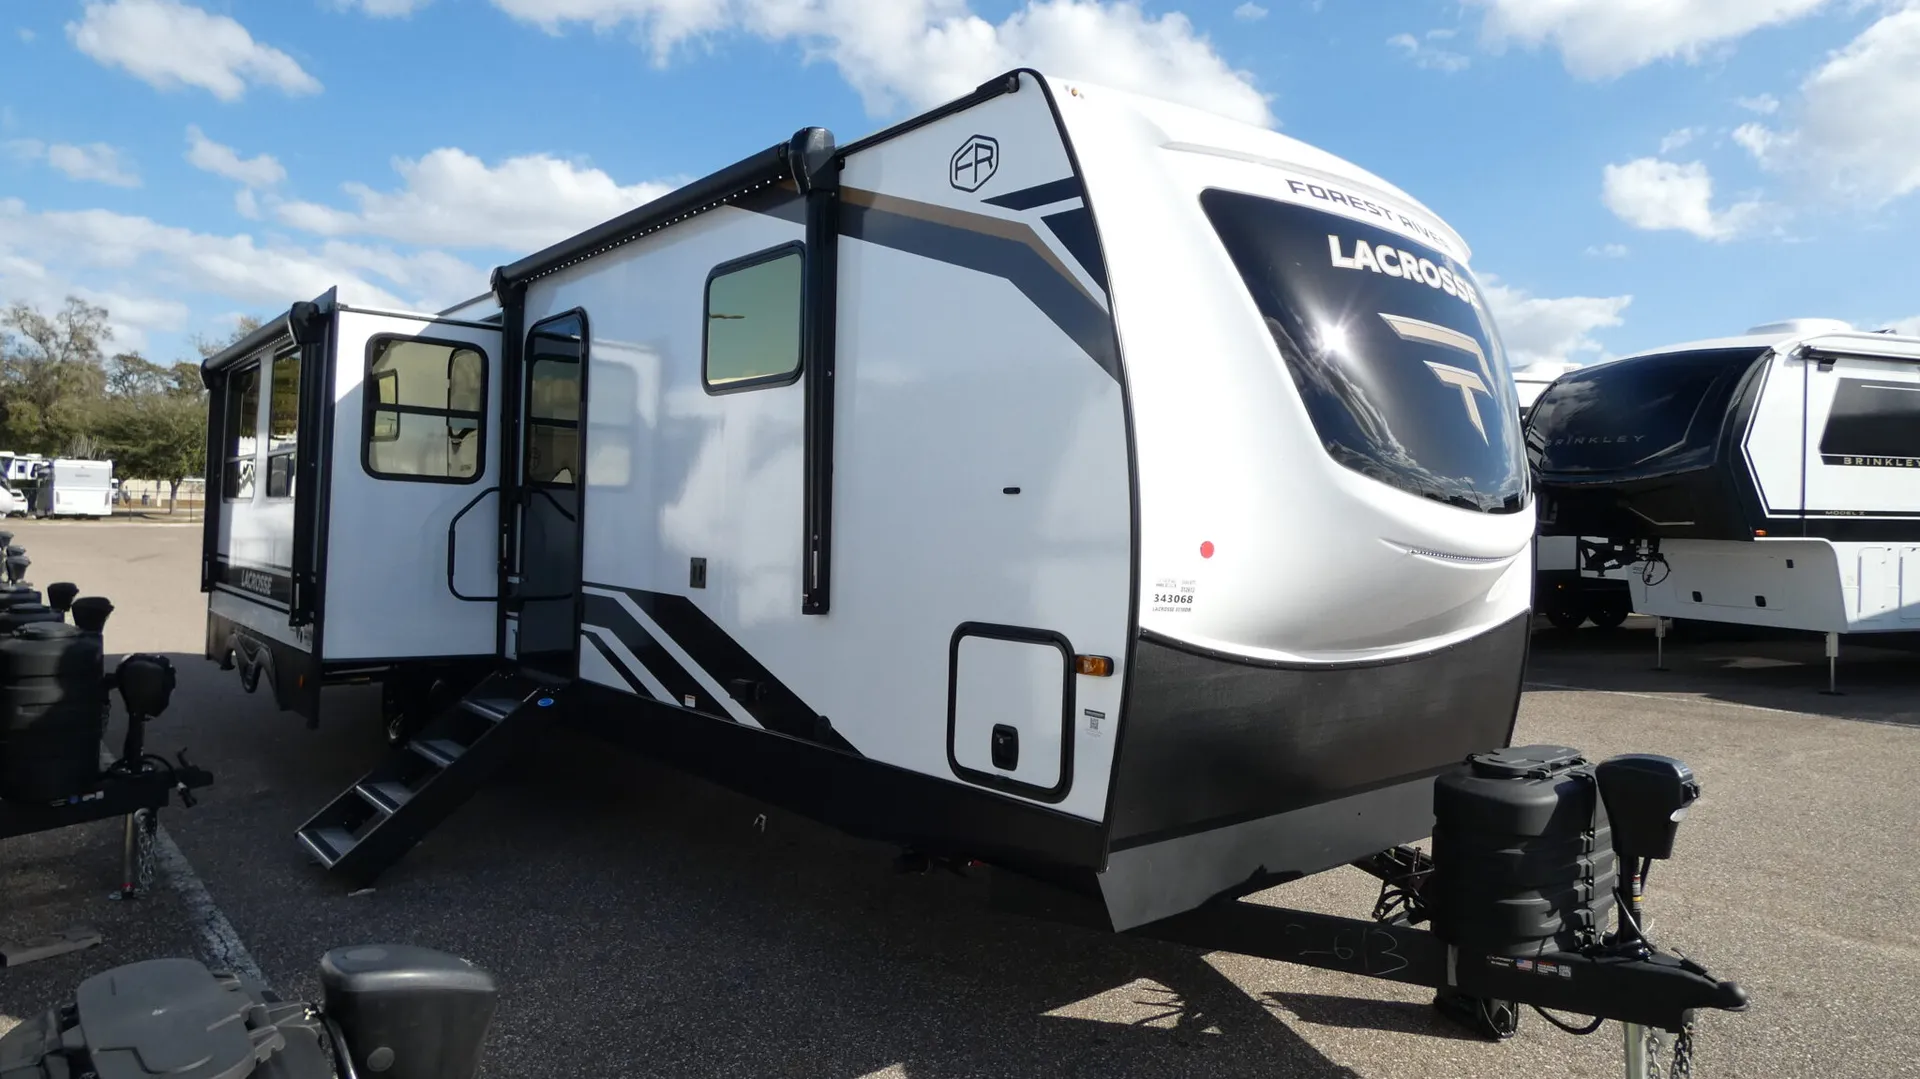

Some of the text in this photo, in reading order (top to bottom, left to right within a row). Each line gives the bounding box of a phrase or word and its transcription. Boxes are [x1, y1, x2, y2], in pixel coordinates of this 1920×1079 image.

[1286, 179, 1394, 221] FOREST
[1328, 234, 1481, 310] LACROSSE
[241, 569, 273, 595] LACROSSE
[1153, 593, 1194, 604] 343068
